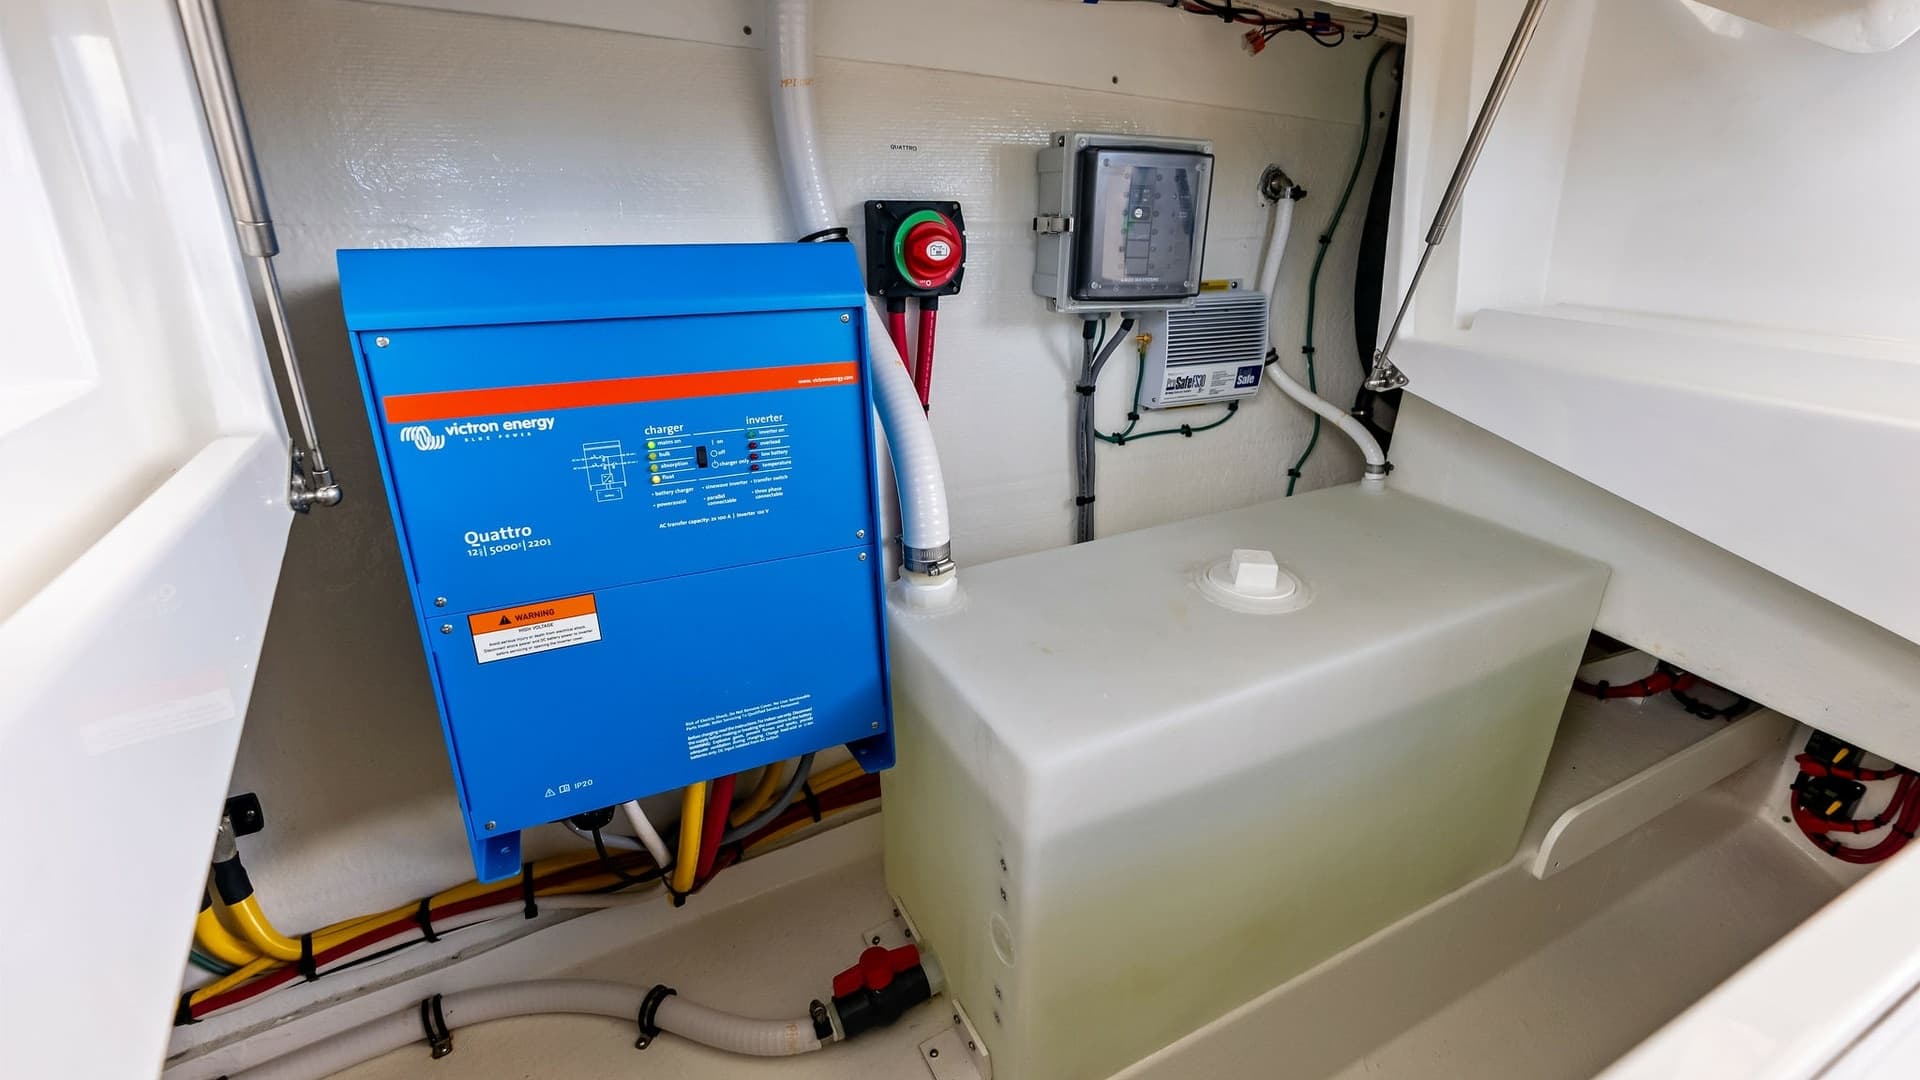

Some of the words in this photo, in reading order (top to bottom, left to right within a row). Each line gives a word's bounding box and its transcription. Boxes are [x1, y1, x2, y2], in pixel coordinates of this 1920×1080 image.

[890, 144, 918, 152] QUATTRO
[1237, 375, 1255, 385] Safe
[746, 414, 783, 424] inverter
[445, 422, 498, 436] victron
[503, 417, 554, 431] energy
[644, 424, 684, 436] charger
[464, 526, 532, 547] Quattro
[515, 608, 555, 621] WARNING
[574, 779, 593, 789] IP20
